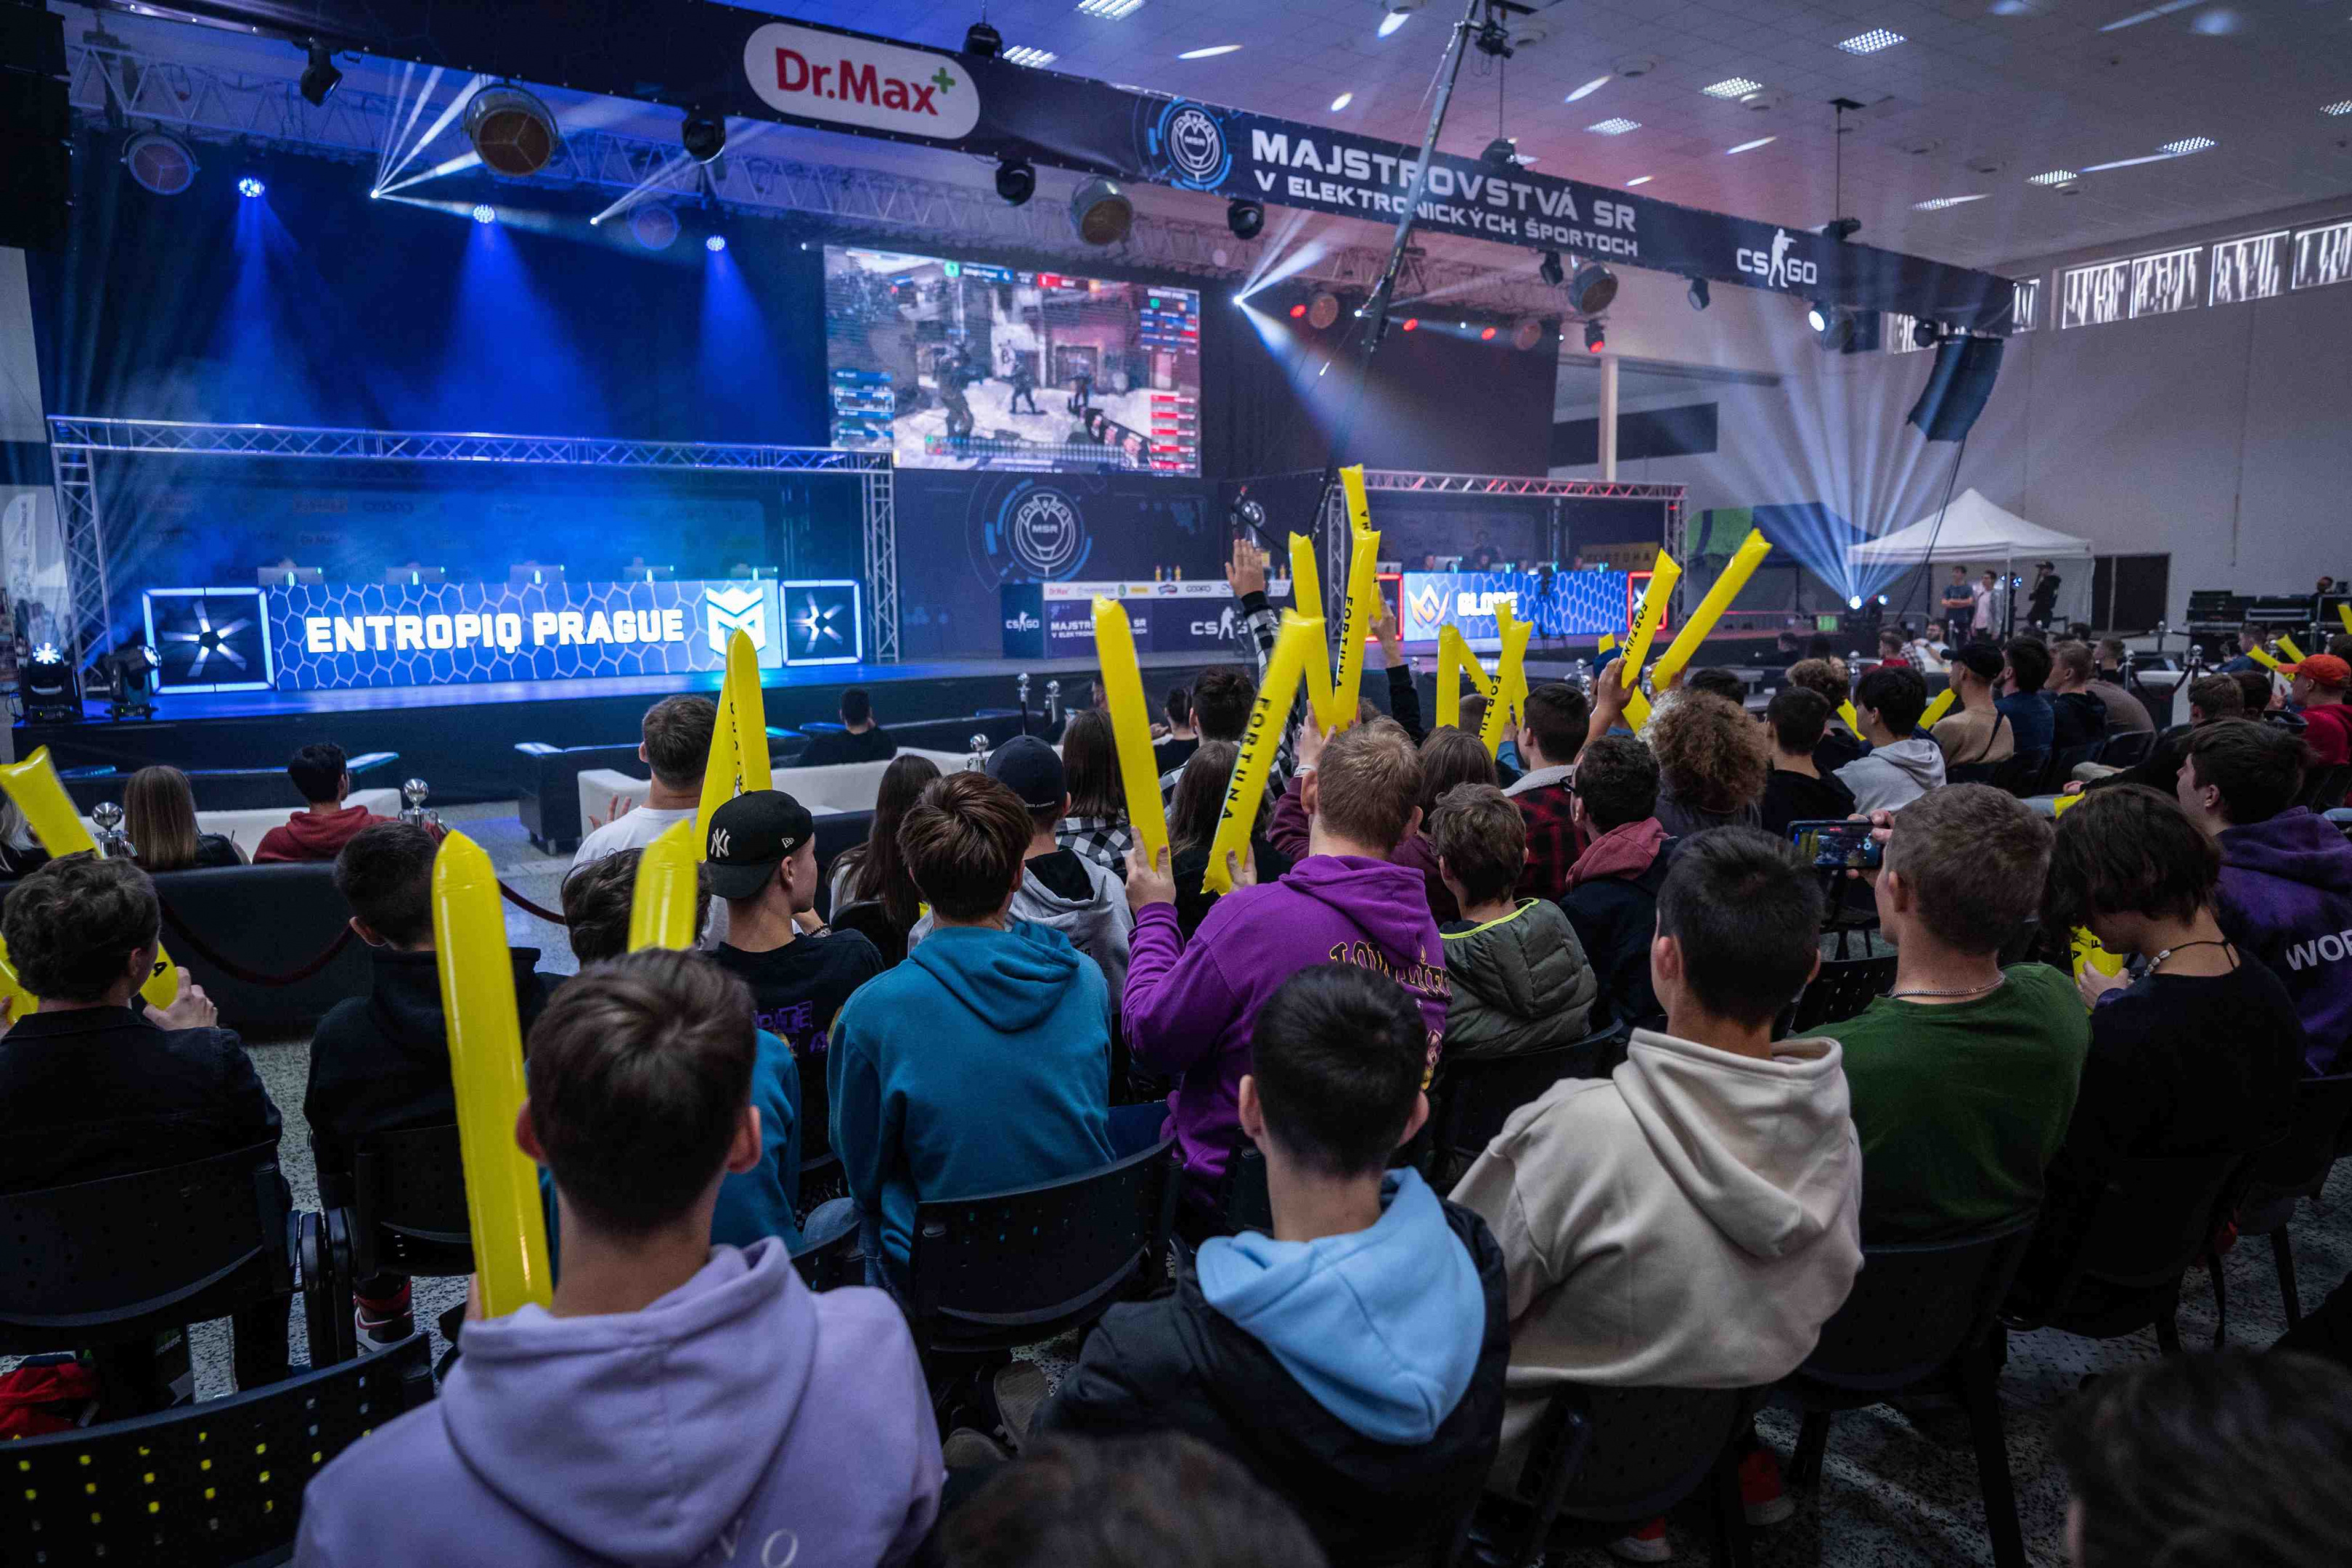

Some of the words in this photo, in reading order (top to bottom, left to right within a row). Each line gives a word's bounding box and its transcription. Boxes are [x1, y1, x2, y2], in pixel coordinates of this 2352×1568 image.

[1254, 169, 1276, 192] V
[1524, 216, 1638, 256] ŠPORTOCH
[1593, 200, 1636, 232] SR
[1032, 524, 1058, 534] MSR
[306, 613, 522, 653] ENTROPIQ
[533, 608, 684, 646] PRAGUE
[1622, 603, 1648, 656] FORTUN
[1222, 697, 1272, 820] FORTUNA
